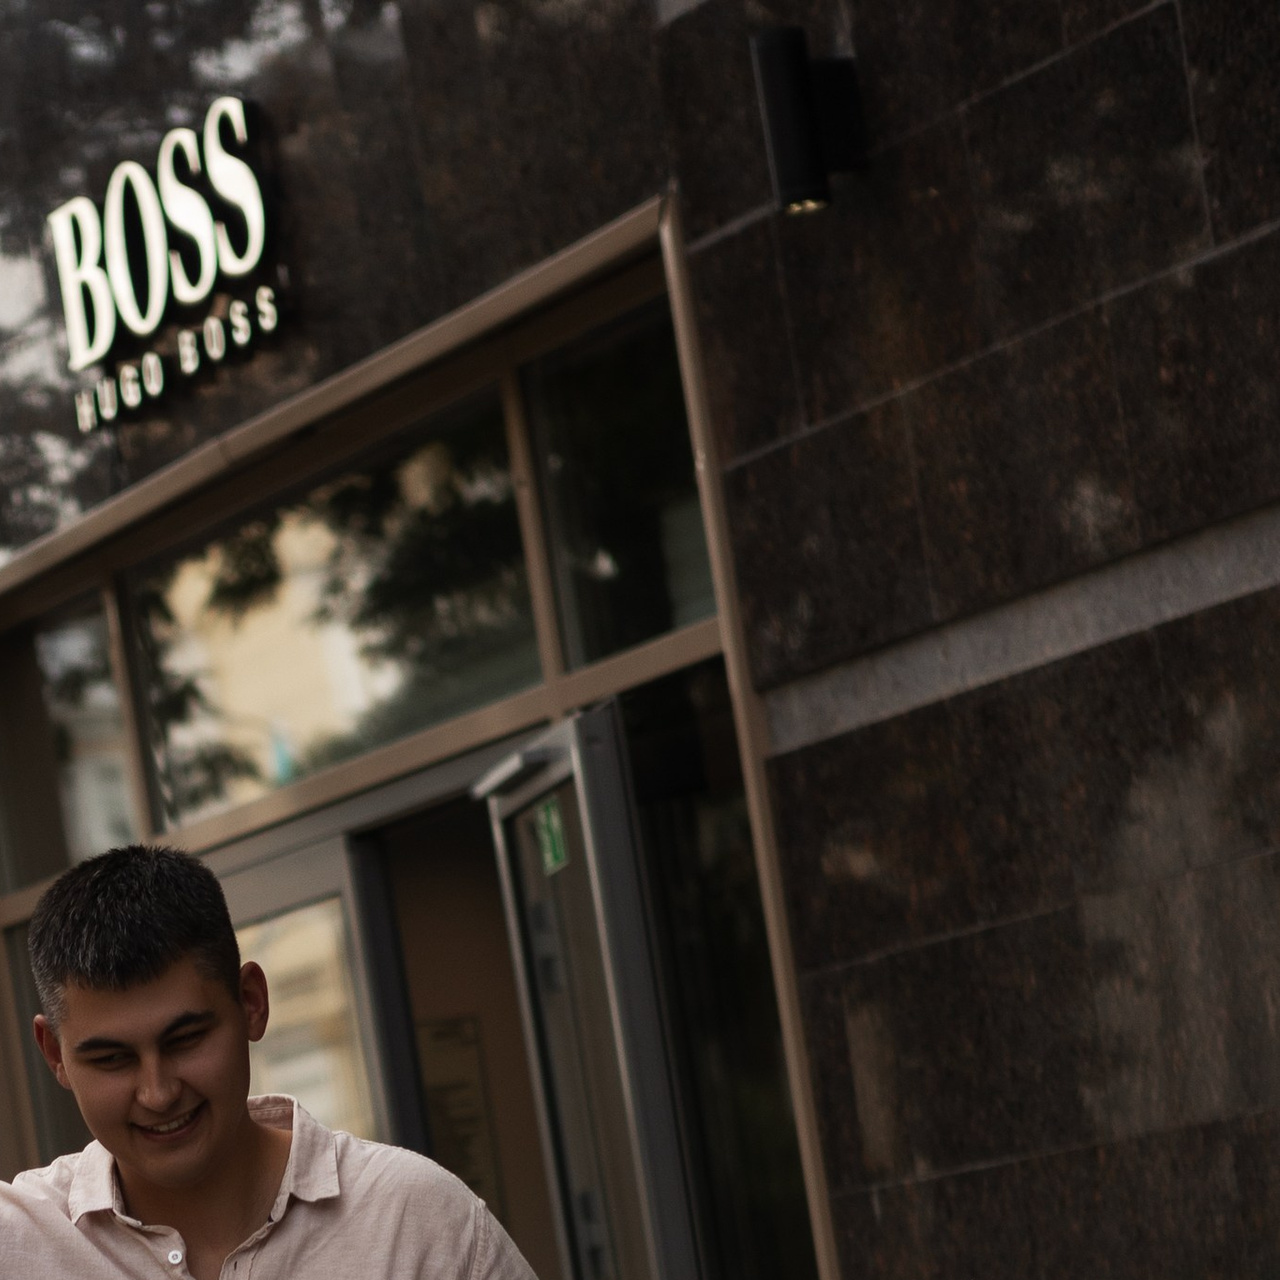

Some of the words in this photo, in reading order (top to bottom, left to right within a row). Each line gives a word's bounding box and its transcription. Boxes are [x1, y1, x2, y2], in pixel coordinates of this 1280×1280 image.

[47, 96, 265, 372] BOSS
[75, 352, 164, 433] HUGO
[177, 285, 278, 375] BOSS
